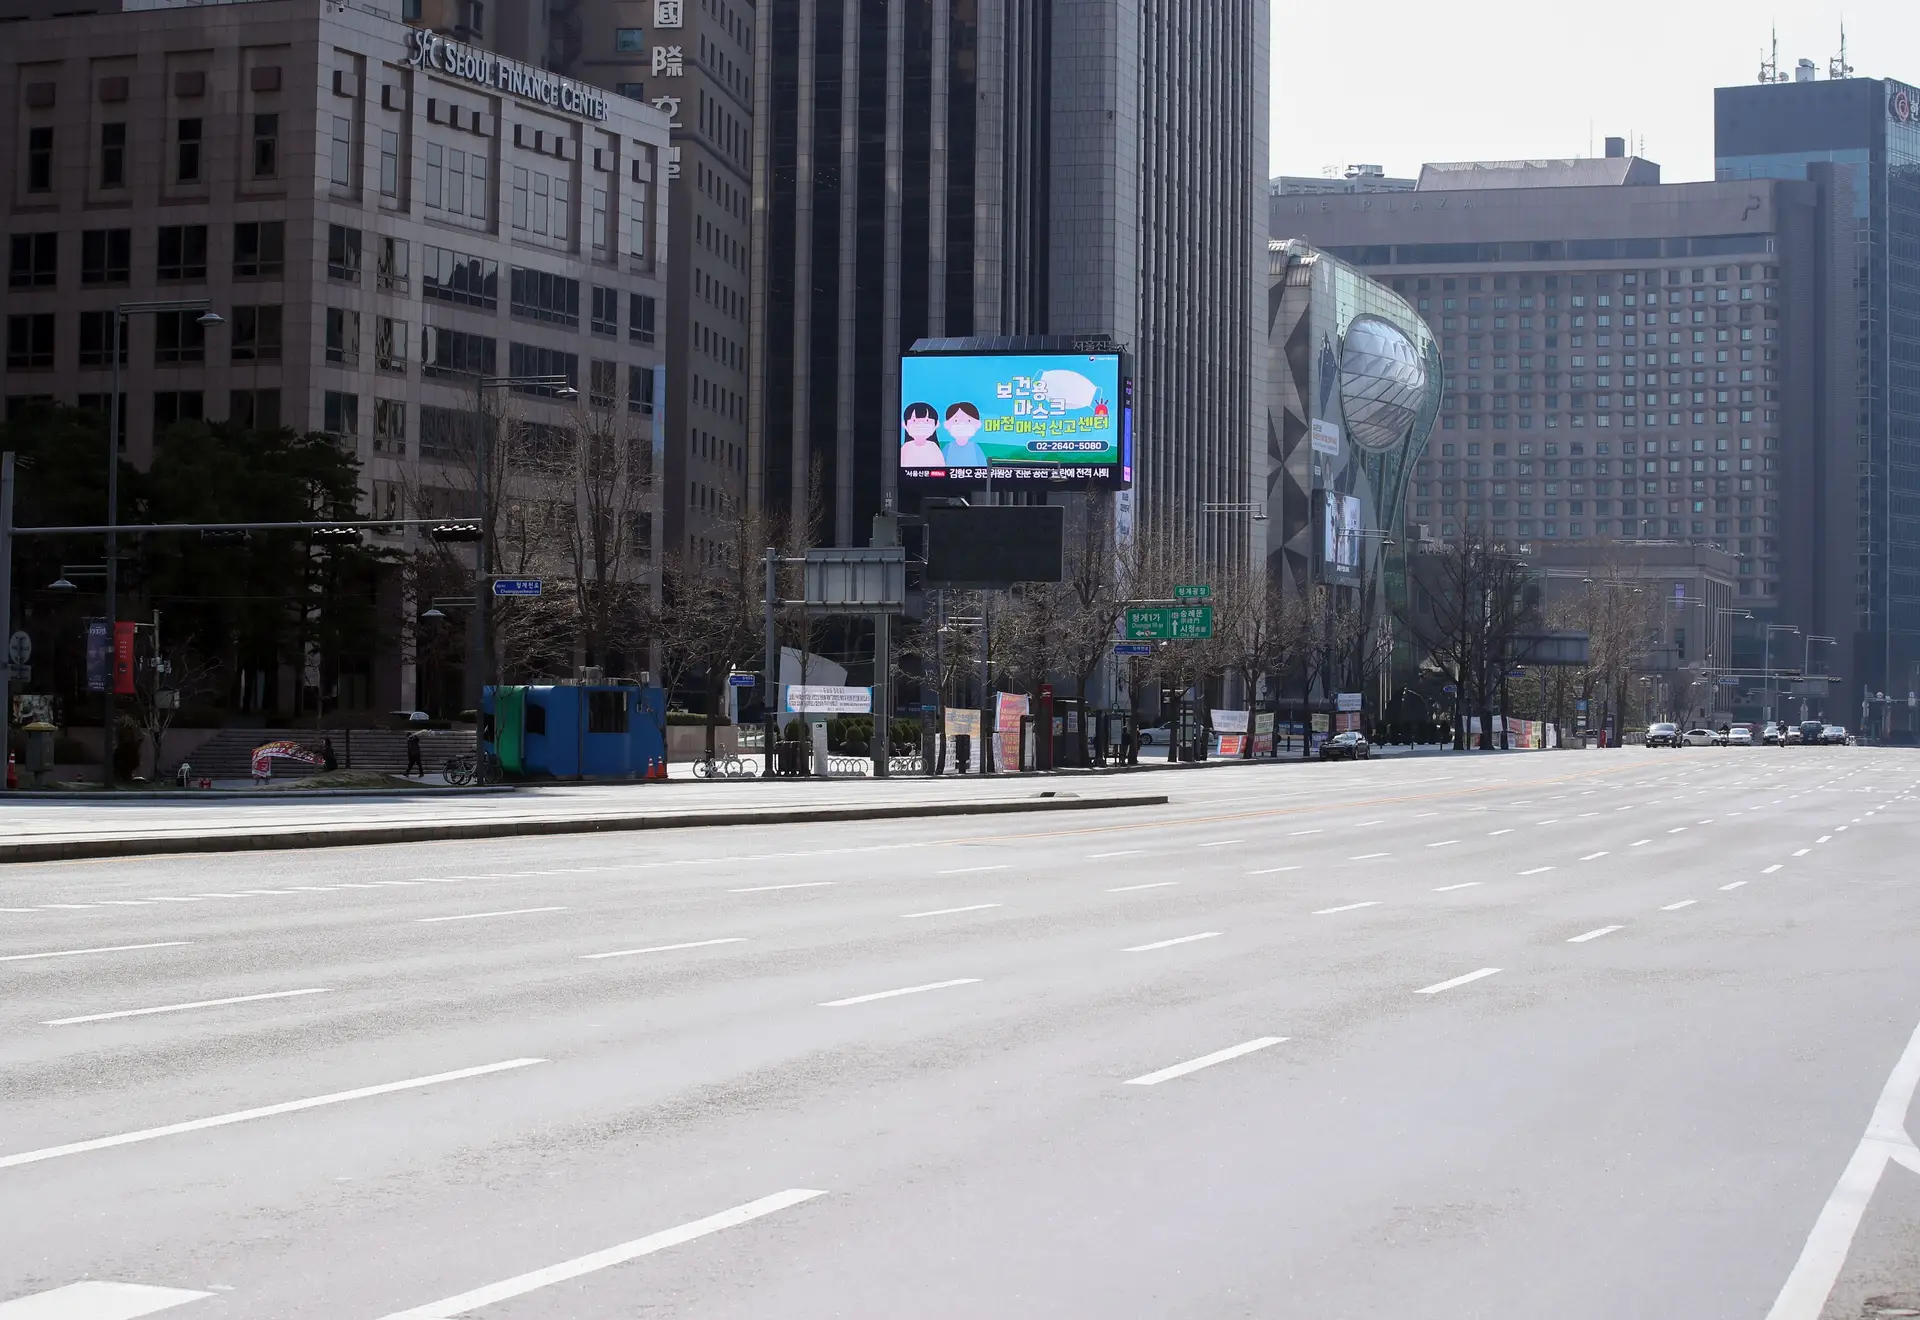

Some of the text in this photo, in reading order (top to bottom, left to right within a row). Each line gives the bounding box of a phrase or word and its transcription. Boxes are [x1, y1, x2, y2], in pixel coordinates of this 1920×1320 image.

[445, 44, 495, 85] SEOUL
[499, 61, 559, 106] FINANCE
[561, 83, 609, 121] CENTER
[996, 375, 1049, 402] 보건용
[1013, 398, 1067, 420] 마스크
[1048, 419, 1077, 436] 신고
[1077, 415, 1110, 433] 센터
[1036, 441, 1102, 451] 02-2640-5080
[949, 468, 973, 479] 김형오
[1180, 609, 1203, 618] 숭례문
[1180, 624, 1195, 633] 시청
